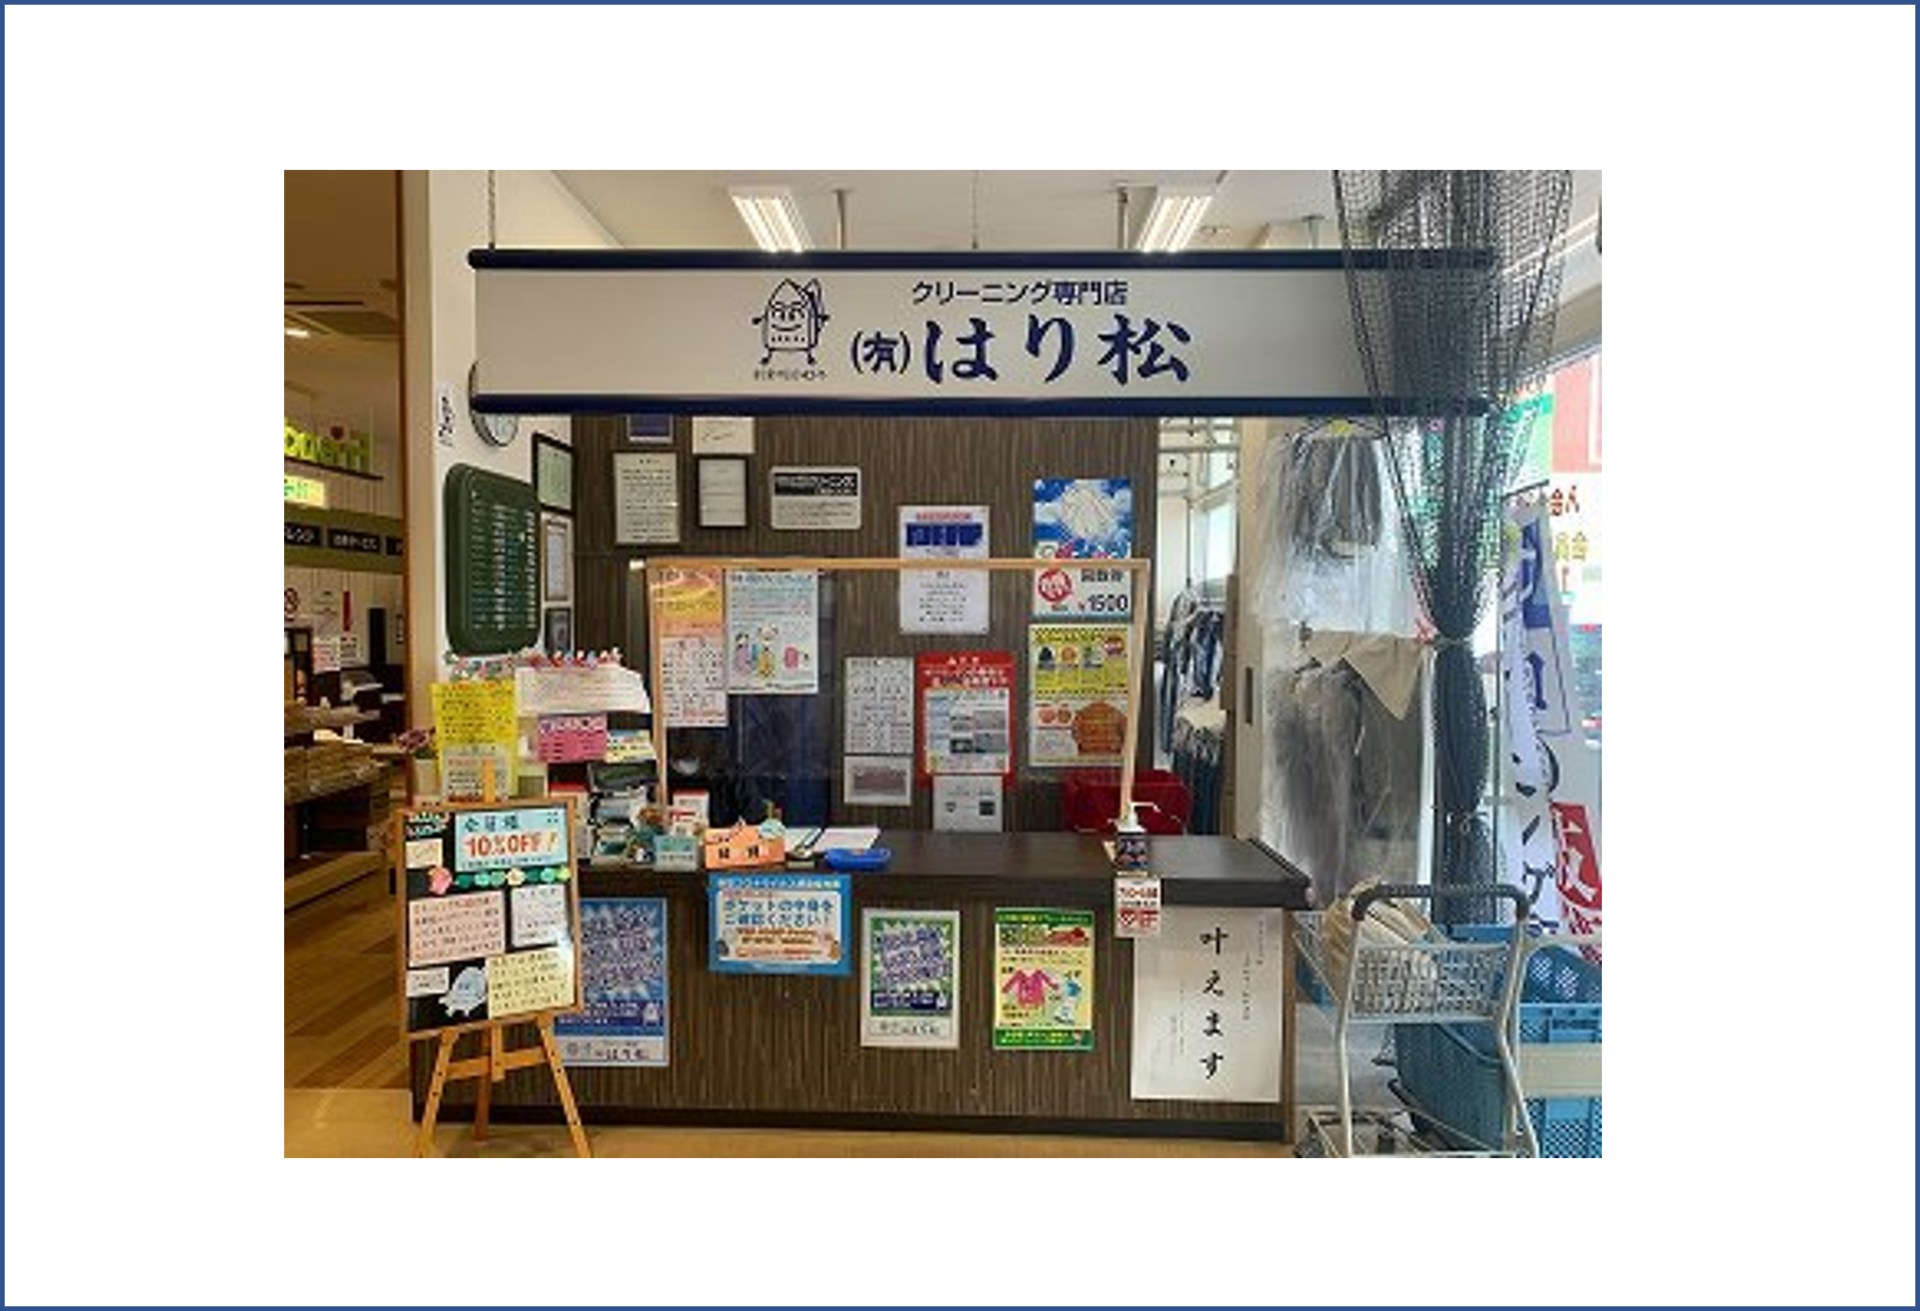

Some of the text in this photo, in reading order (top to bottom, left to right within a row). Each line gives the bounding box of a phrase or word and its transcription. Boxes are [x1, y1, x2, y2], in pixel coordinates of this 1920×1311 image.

[912, 280, 1128, 306] クリーニング専門店
[1199, 926, 1230, 1081] 叶えます
